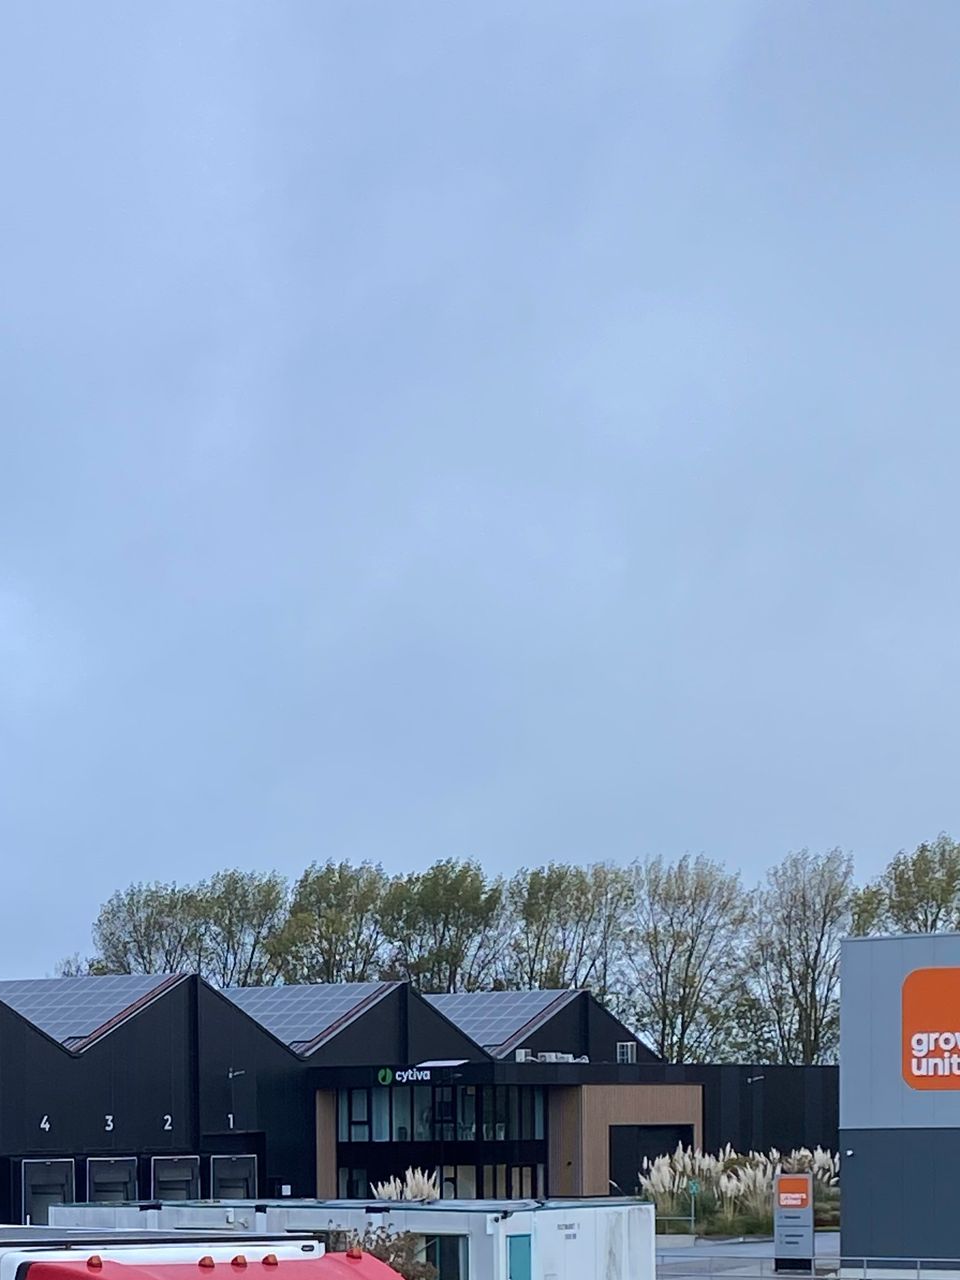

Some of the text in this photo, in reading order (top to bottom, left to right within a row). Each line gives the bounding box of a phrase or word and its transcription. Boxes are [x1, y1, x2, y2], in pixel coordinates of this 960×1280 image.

[911, 1032, 960, 1057] gro
[395, 1068, 431, 1083] cytiva
[40, 1115, 50, 1131] 4
[105, 1115, 114, 1131] 3
[163, 1114, 173, 1130] 2
[227, 1113, 234, 1129] 1
